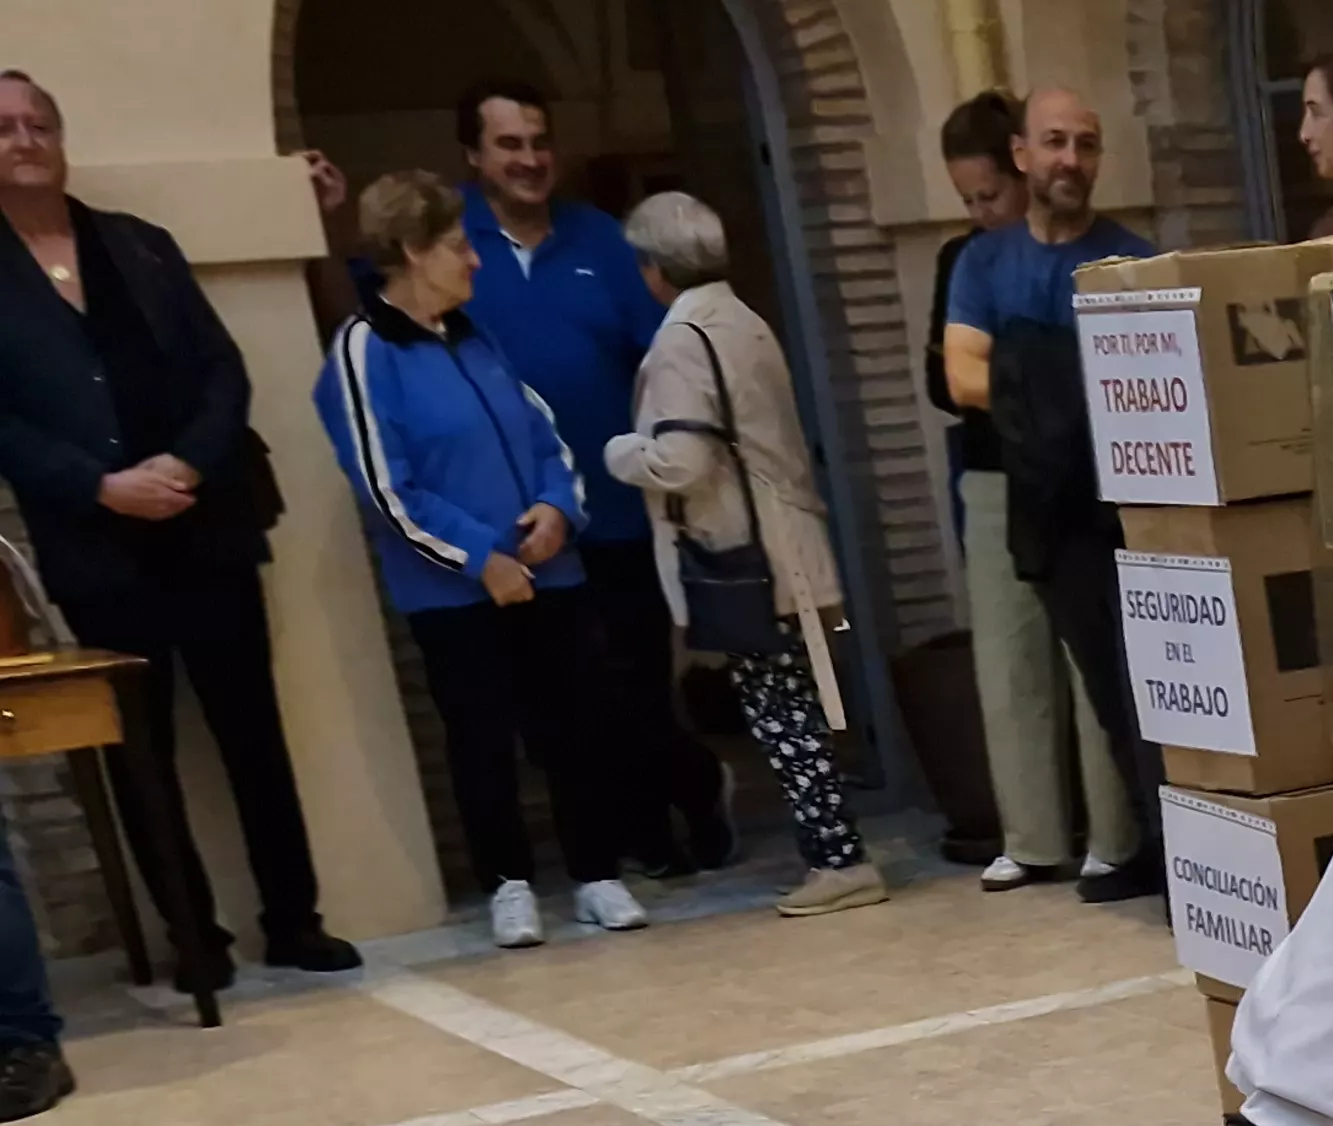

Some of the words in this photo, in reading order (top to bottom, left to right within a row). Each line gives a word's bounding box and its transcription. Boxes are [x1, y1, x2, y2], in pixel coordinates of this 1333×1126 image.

[1092, 333, 1120, 356] POR
[1135, 331, 1160, 356] POR
[1100, 377, 1188, 413] TRABAJO
[1111, 441, 1196, 477] DECENTE
[1126, 589, 1226, 627] SEGURIDAD
[1165, 640, 1182, 663] EN
[1183, 643, 1196, 664] EL
[1145, 679, 1229, 718] TRABAJO
[1173, 855, 1279, 911] CONCILIACIÓN
[1185, 902, 1274, 957] FAMILIAR
